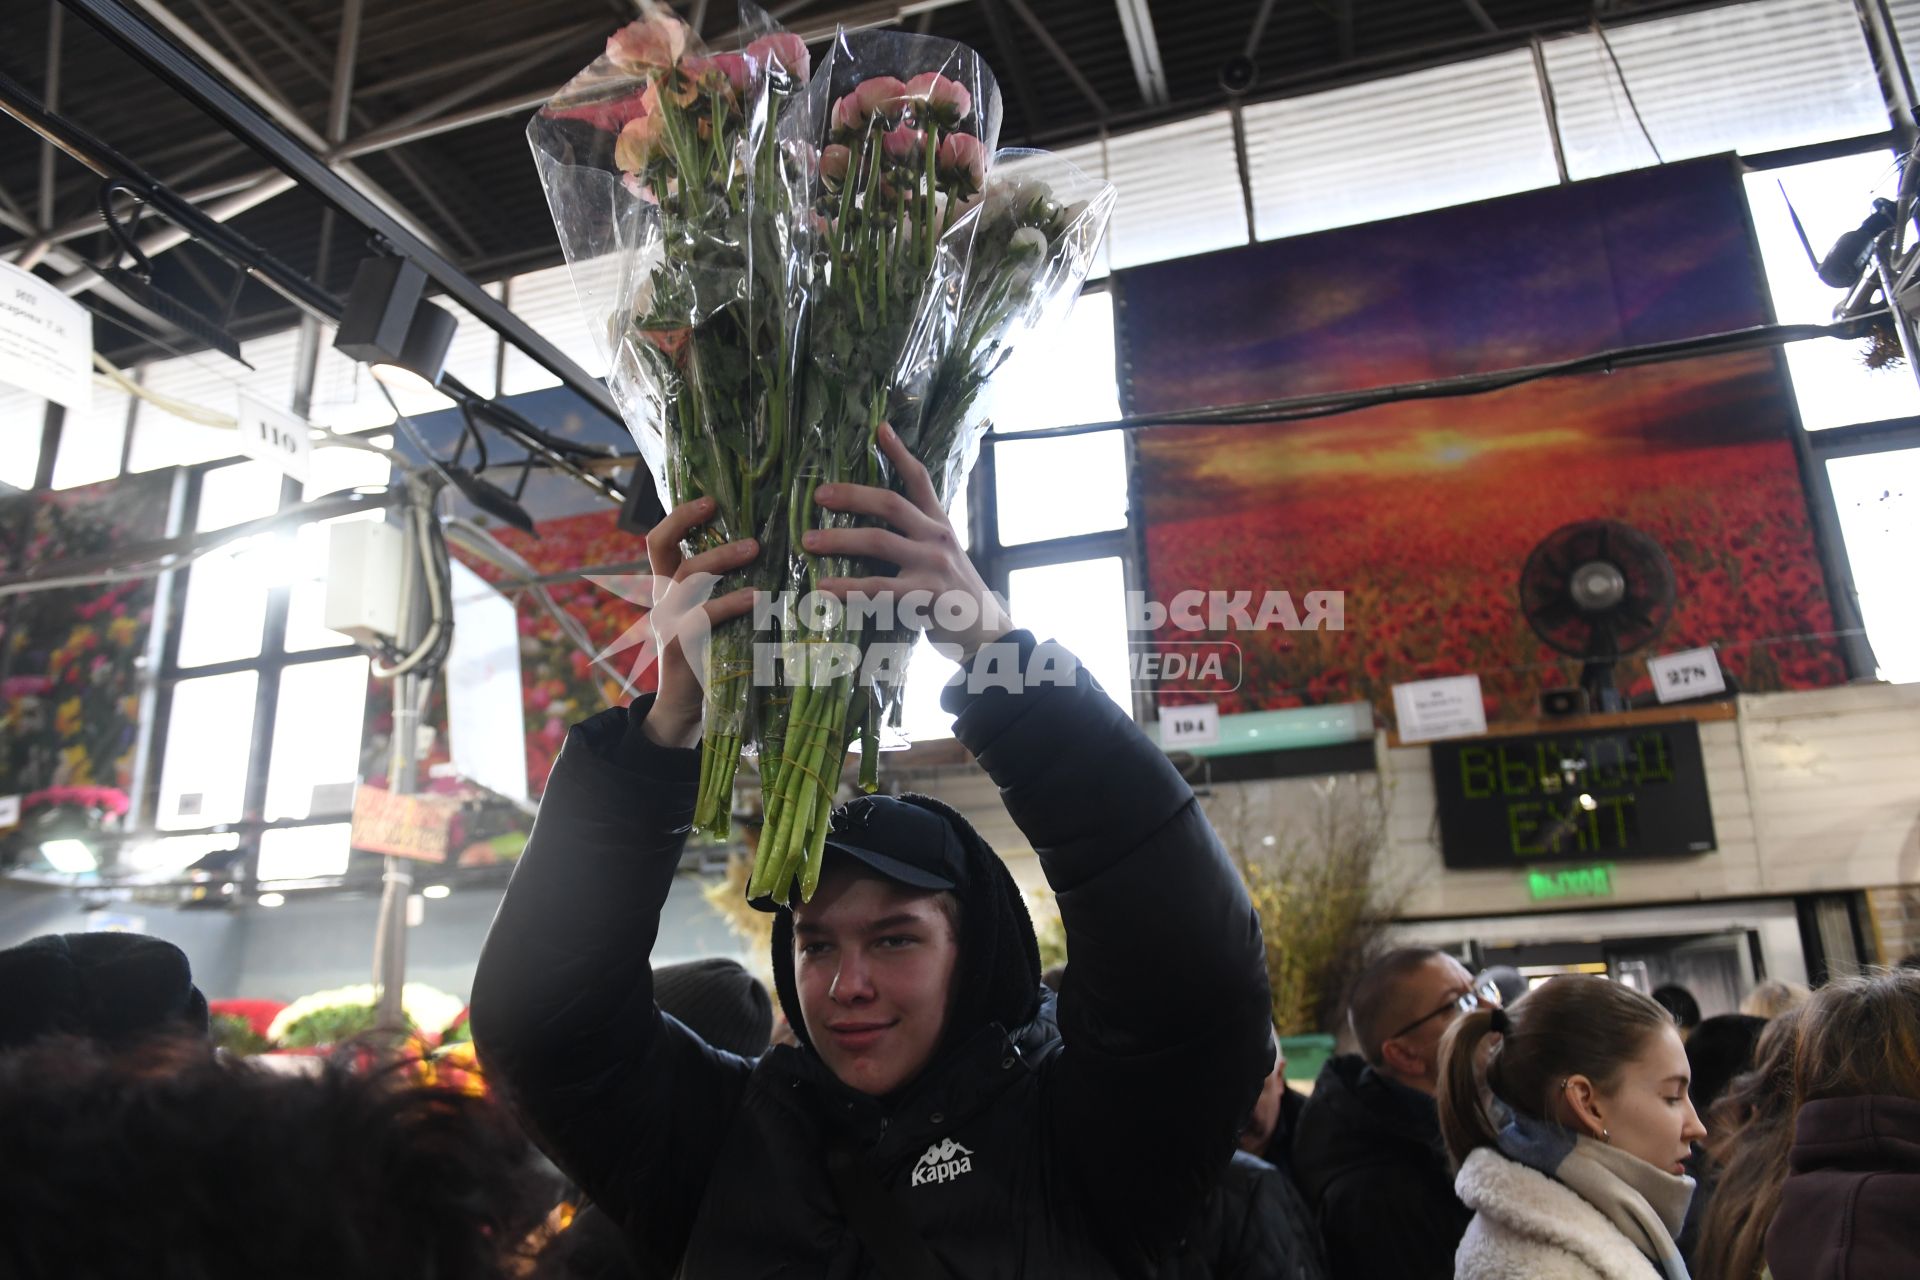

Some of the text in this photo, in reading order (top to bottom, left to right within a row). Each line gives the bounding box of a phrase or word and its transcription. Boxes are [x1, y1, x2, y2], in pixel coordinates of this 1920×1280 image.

[260, 421, 297, 454] 110
[1459, 732, 1675, 799] ВЫХОД
[1507, 793, 1636, 855] EXIT
[911, 1156, 972, 1187] Kappa
